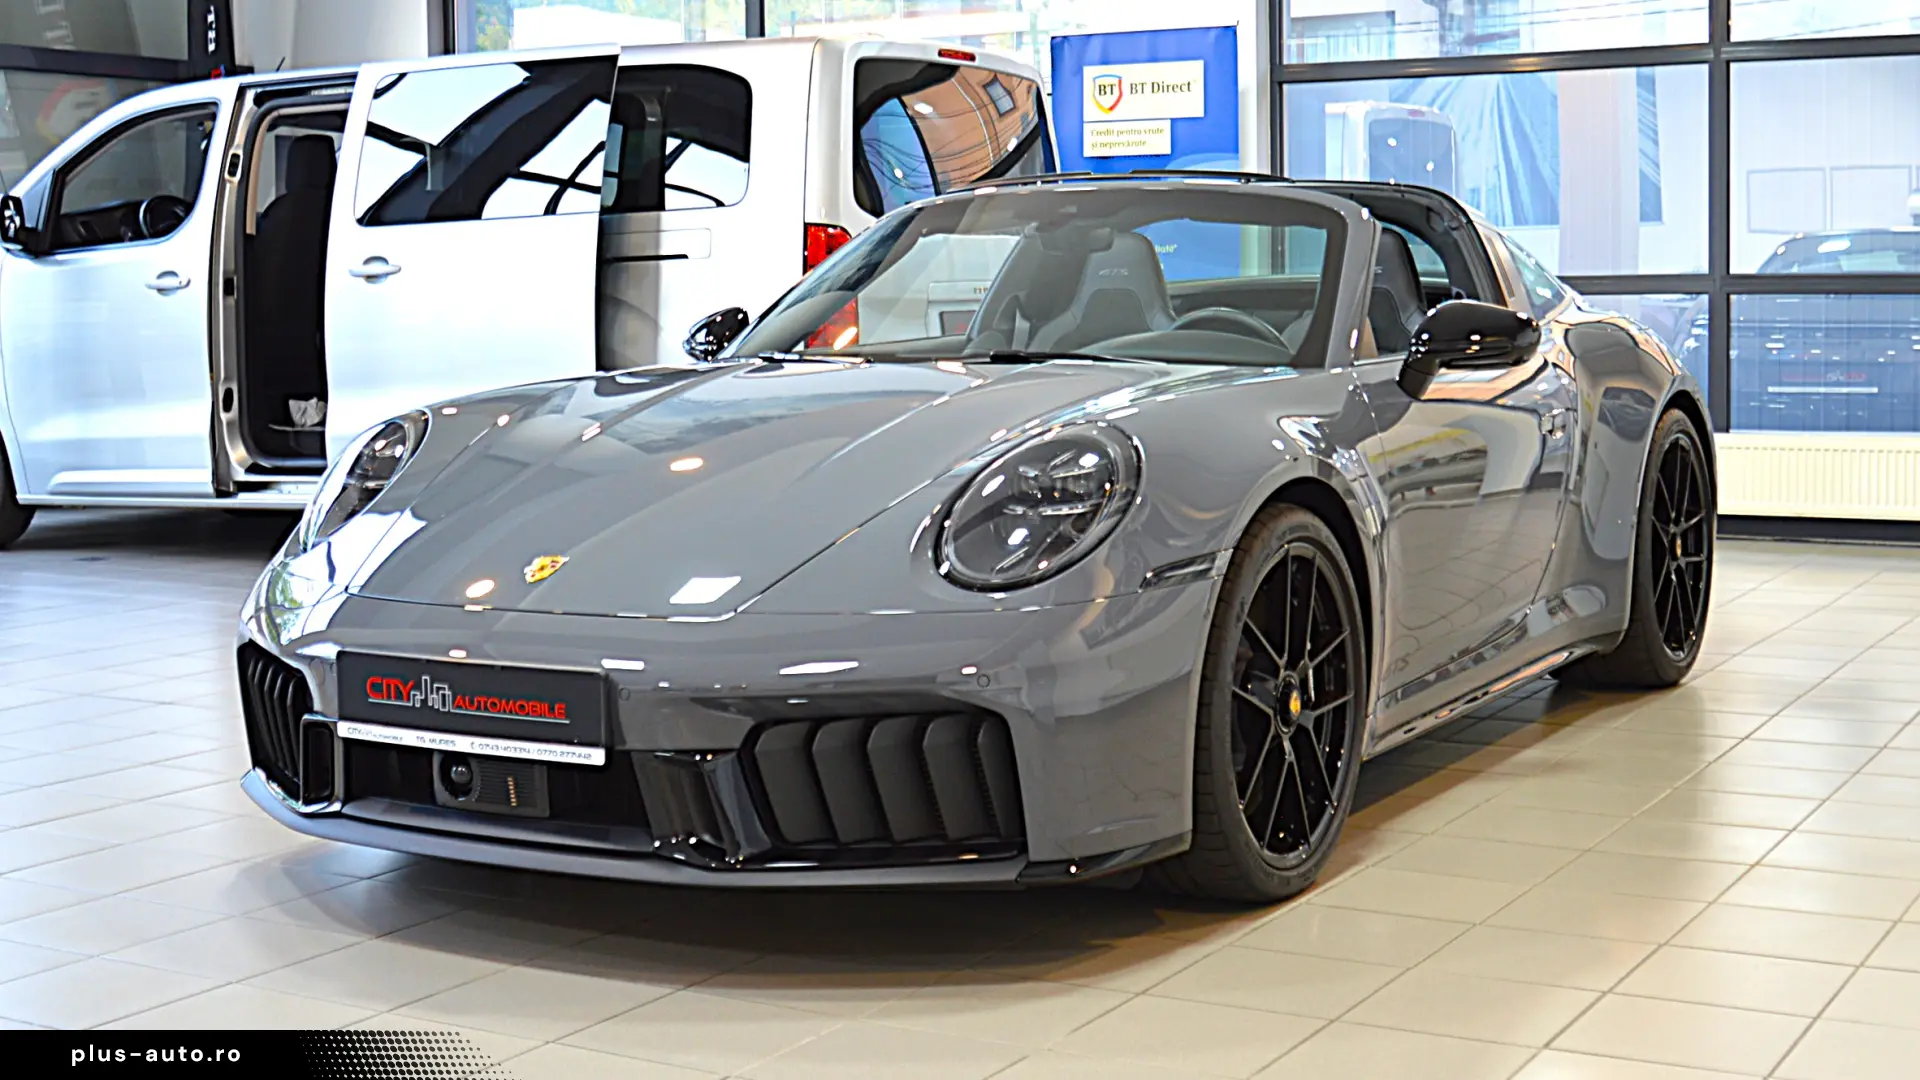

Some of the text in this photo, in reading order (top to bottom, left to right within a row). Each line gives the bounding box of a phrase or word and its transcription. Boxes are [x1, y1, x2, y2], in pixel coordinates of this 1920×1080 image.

[1098, 84, 1117, 97] BT
[1129, 80, 1192, 95] BT Direct
[1091, 128, 1115, 137] Credit
[366, 676, 567, 720] CITY AUTOMOBILE
